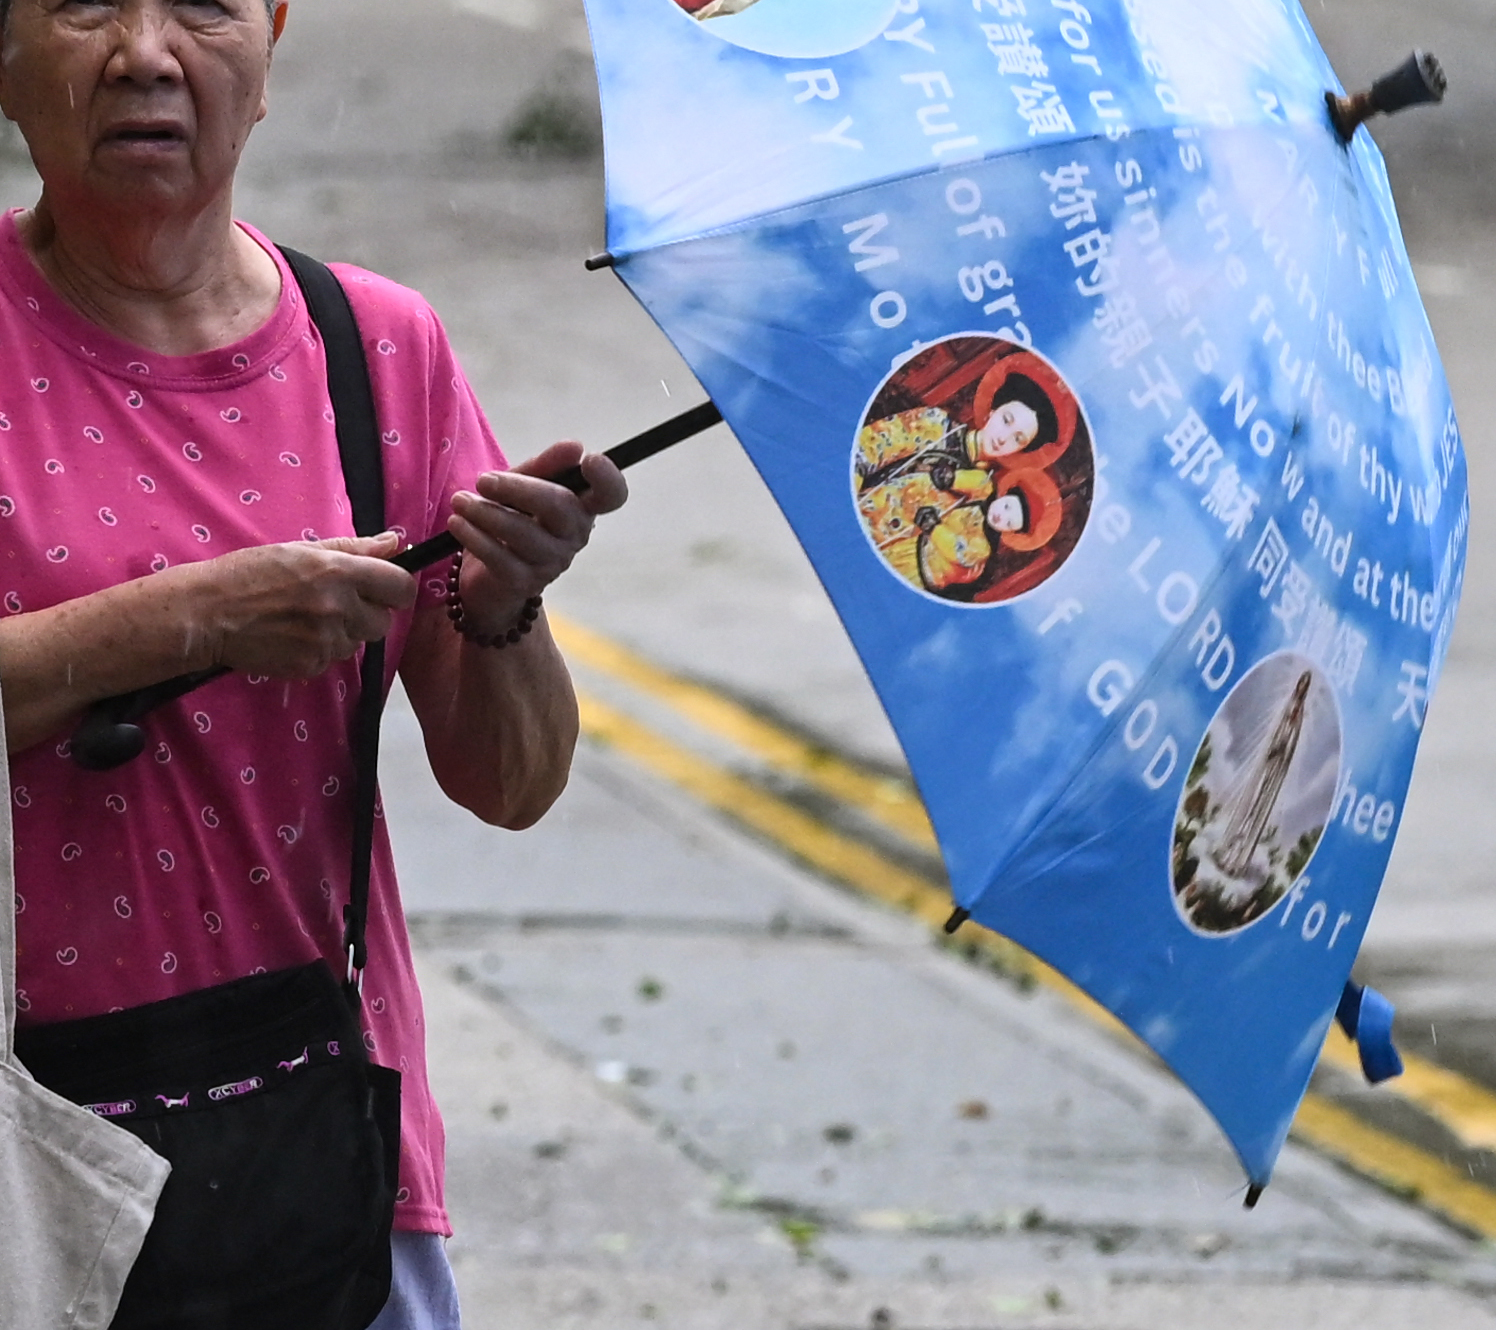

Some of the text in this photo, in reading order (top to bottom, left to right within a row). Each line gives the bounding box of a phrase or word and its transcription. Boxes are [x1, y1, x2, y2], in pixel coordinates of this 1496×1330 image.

[945, 177, 1006, 241] of
[957, 259, 1033, 348] gra
[1088, 90, 1132, 143] us
[1115, 158, 1221, 376] sinners
[1301, 496, 1353, 578] and
[1353, 556, 1384, 608] at
[1389, 570, 1435, 632] the
[1172, 126, 1203, 173] is
[1196, 186, 1249, 291] the
[1327, 411, 1357, 467] of
[1359, 443, 1404, 526] thy
[1327, 310, 1382, 405] thee
[784, 67, 865, 152] RY
[1037, 597, 1084, 636] f
[1086, 659, 1179, 790] GOD
[1279, 875, 1352, 951] for
[1127, 536, 1236, 691] LORD
[1329, 768, 1395, 844] hee
